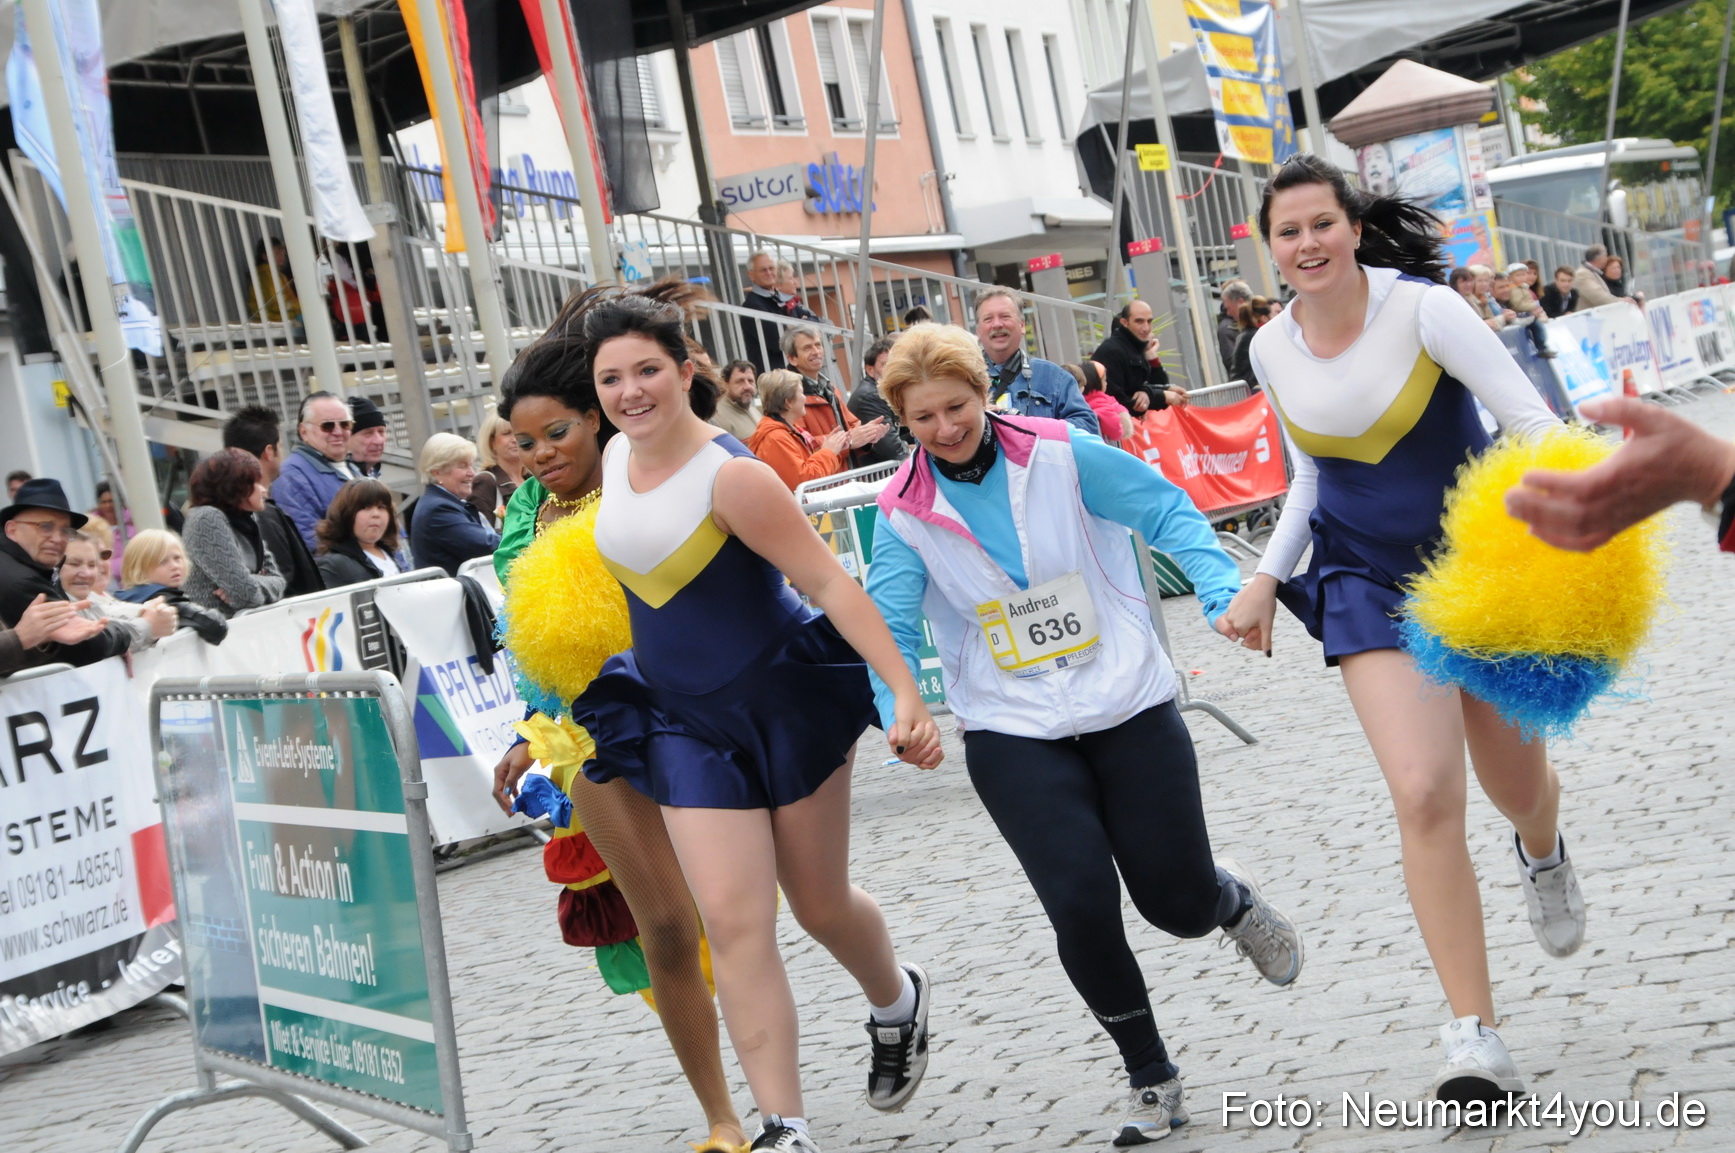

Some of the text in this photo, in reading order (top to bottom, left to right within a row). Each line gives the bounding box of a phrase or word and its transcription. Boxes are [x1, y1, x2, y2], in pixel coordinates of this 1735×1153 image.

[1008, 594, 1059, 618] Andrea
[1028, 612, 1082, 646] 636
[991, 633, 1000, 646] D
[0, 696, 109, 788] RZ
[253, 735, 335, 778] Event-Leit-Systeme
[0, 796, 117, 856] STEME
[17, 847, 124, 909] 09181-4855-0
[246, 841, 354, 903] Fun & Action in
[0, 893, 129, 963] www.schwarz.de
[258, 914, 377, 986] sicheren Bahnen!
[270, 1020, 405, 1085] Miet & Service Line: 09181 6352
